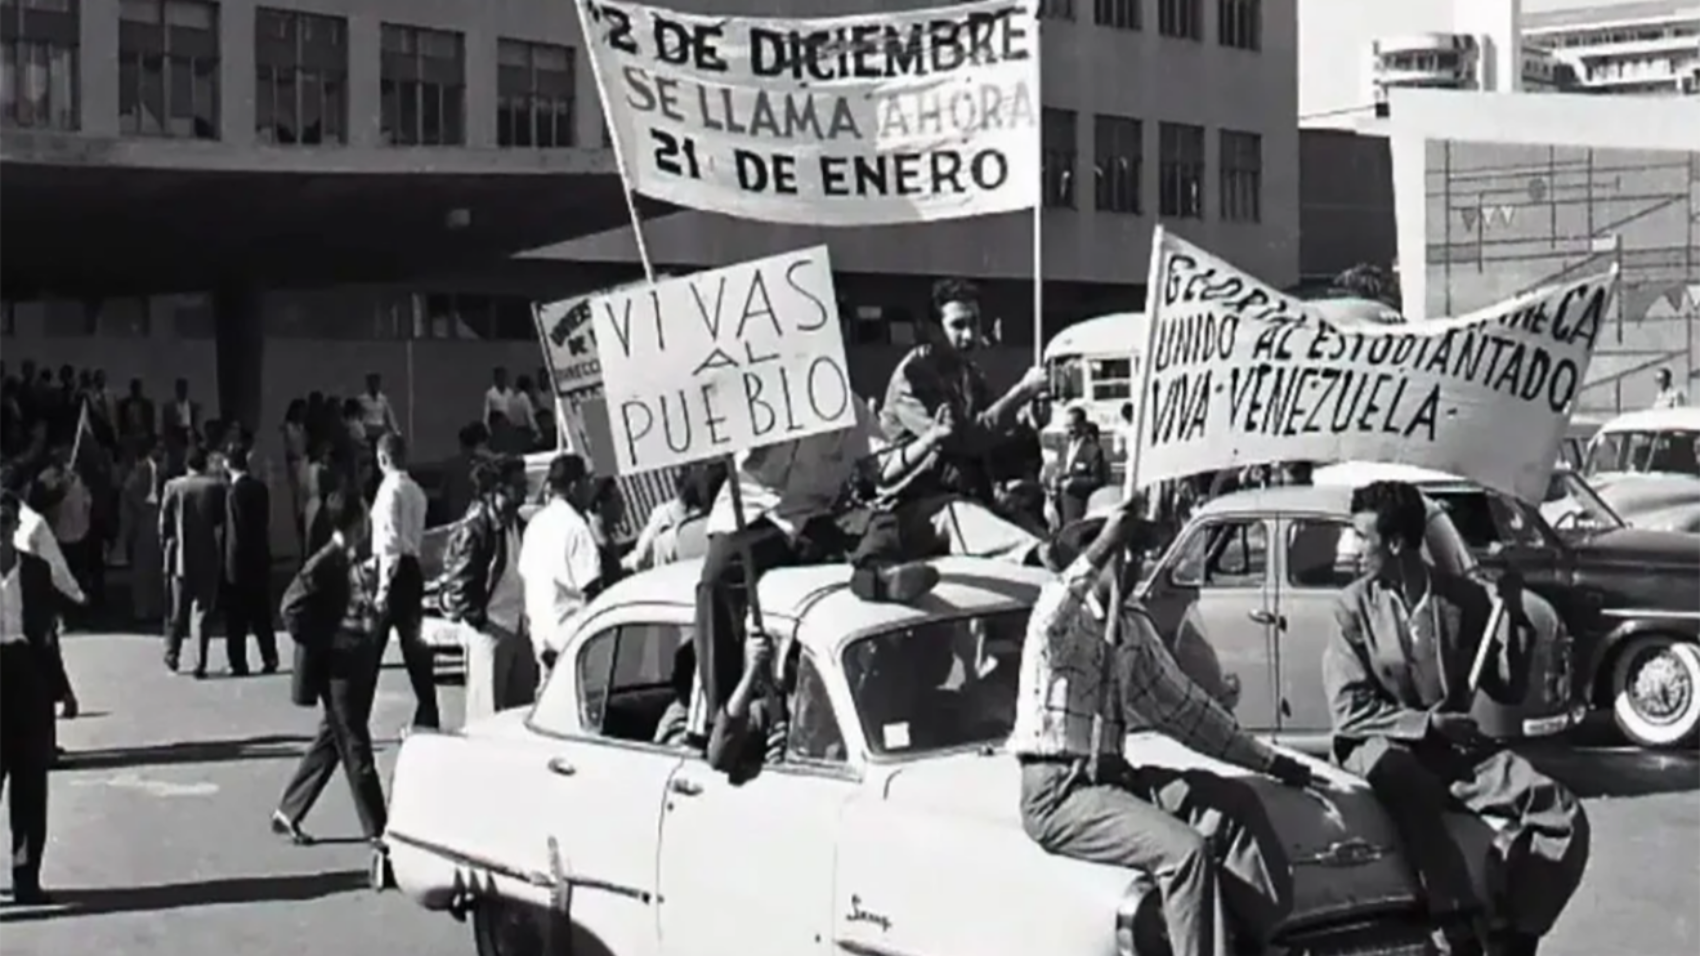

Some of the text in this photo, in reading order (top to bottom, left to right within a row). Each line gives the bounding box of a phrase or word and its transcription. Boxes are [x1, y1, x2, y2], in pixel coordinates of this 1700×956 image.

[652, 13, 727, 71] DE
[750, 6, 1029, 80] DICIEMBRE
[623, 66, 1035, 139] SE LLAMA AHORA
[650, 127, 1008, 196] 21 DE ENERO
[605, 259, 828, 358] VIVAS
[691, 341, 780, 376] AL
[1155, 310, 1577, 412] UNIDO AL ESTUDIANTADO
[621, 356, 848, 466] PUEBLO
